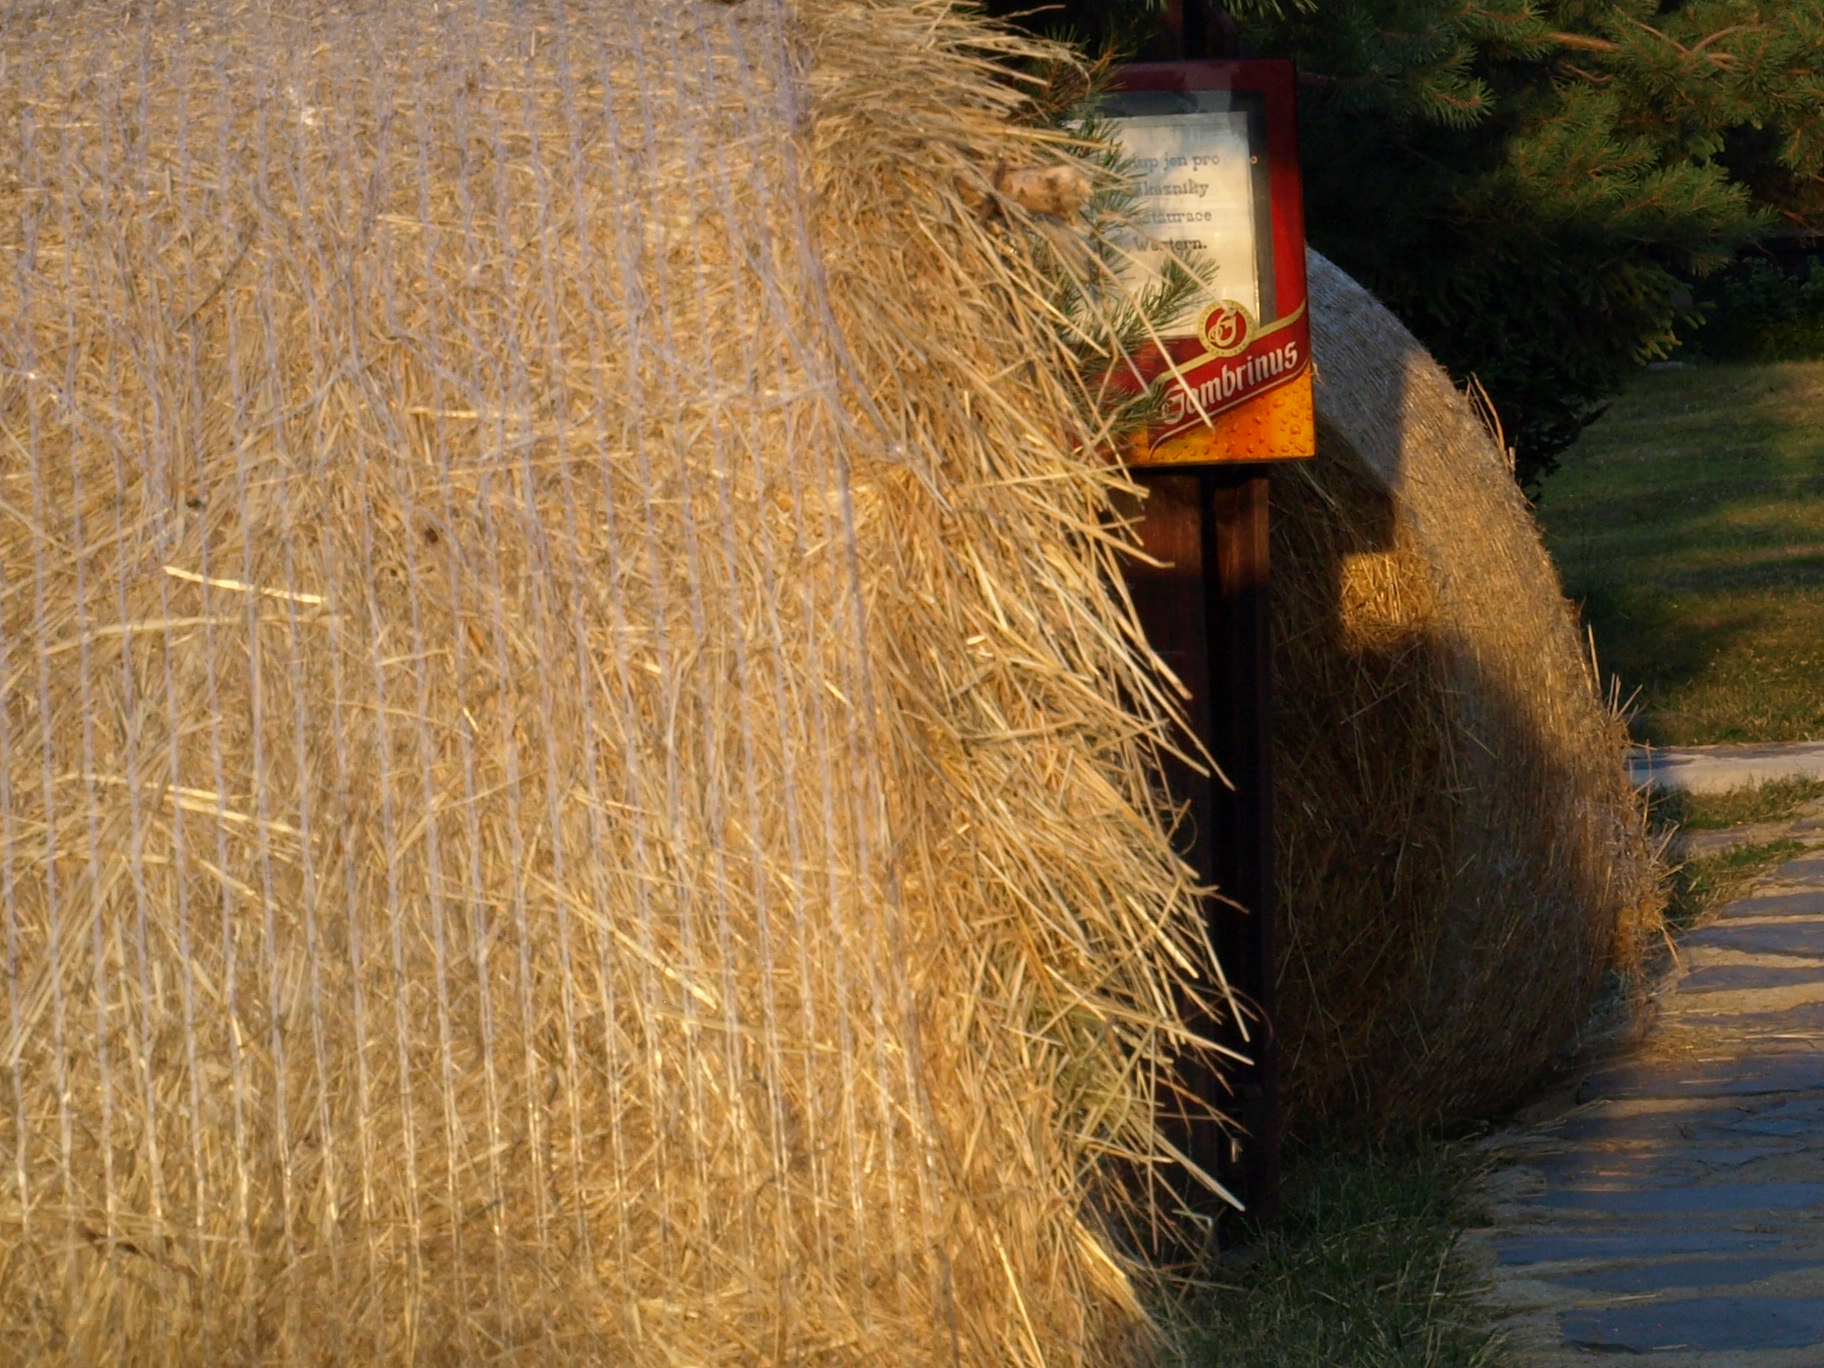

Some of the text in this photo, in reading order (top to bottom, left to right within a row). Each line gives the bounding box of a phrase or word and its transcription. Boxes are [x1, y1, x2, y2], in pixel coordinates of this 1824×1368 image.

[1192, 154, 1220, 172] pro
[1132, 236, 1208, 252] Wetern.
[1160, 341, 1298, 425] Gambrinus
